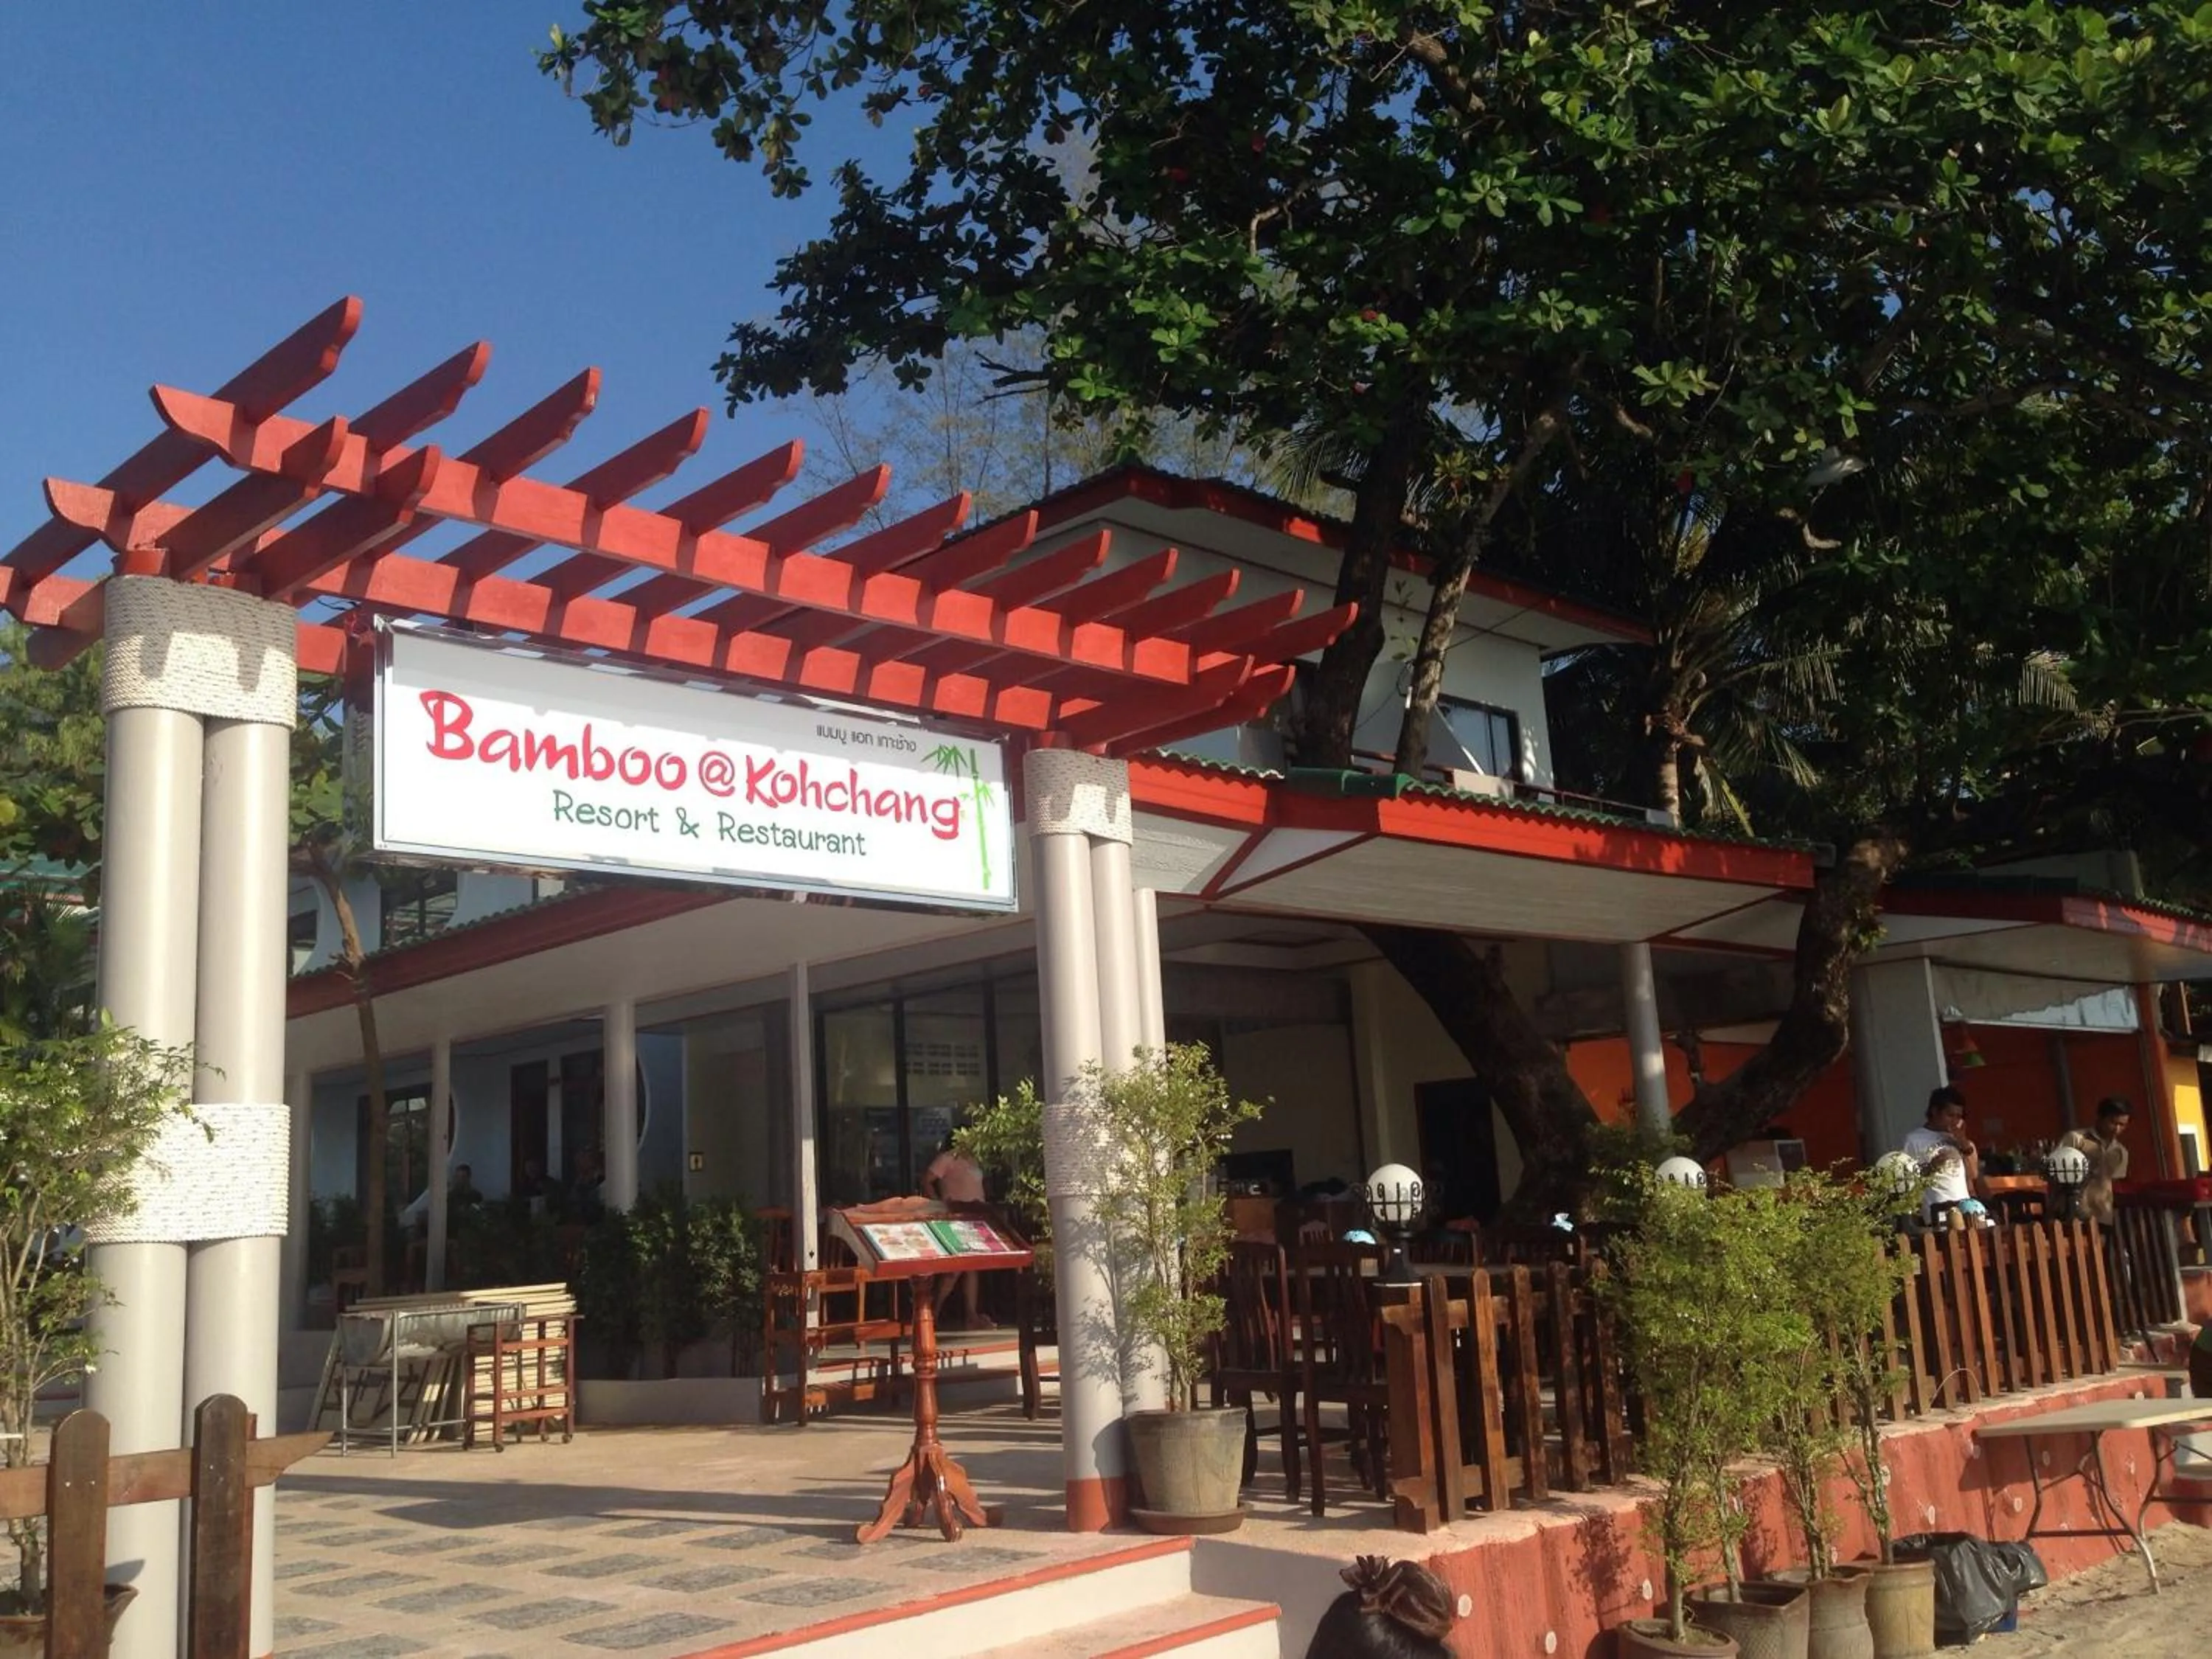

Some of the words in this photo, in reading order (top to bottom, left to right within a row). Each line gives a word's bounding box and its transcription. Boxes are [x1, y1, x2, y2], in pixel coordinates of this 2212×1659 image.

[554, 790, 660, 833] Resort
[676, 807, 699, 838] &
[718, 813, 866, 856] Restaurant
